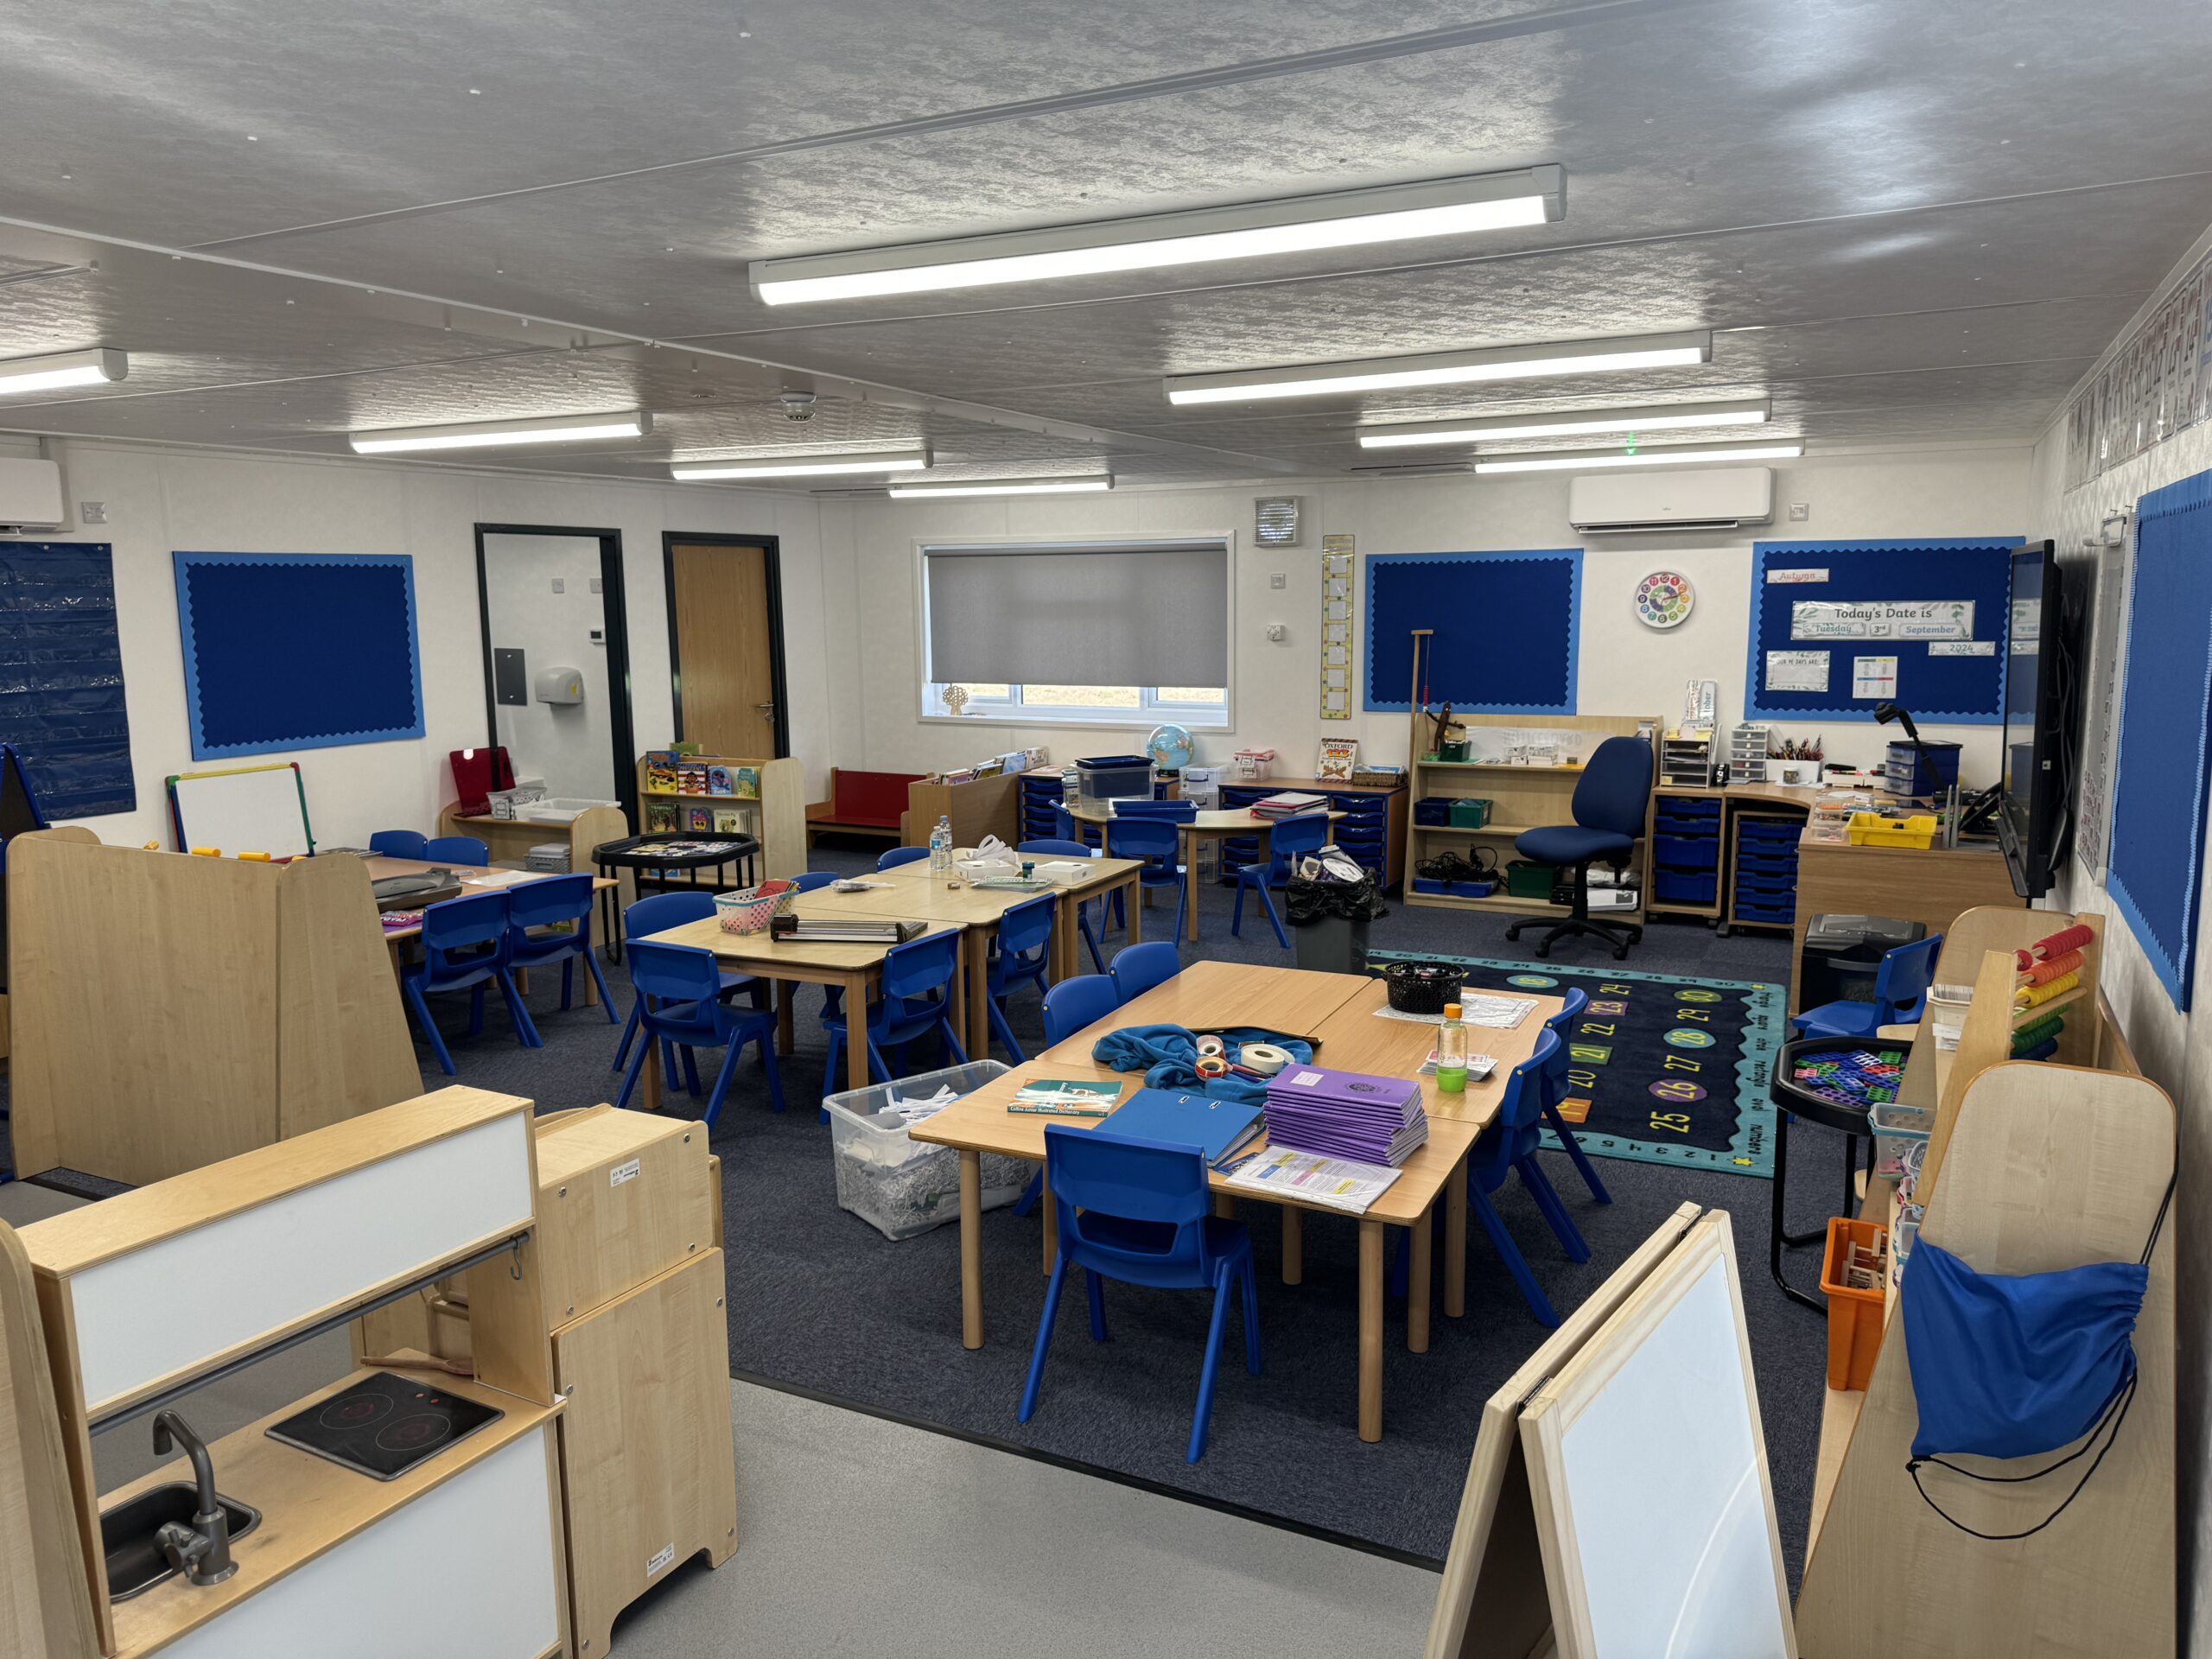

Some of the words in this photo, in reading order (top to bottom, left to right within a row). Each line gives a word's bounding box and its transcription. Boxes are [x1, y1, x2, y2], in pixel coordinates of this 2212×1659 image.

[1778, 571, 1815, 581] Autumn
[1834, 607, 1882, 621] Today's
[1886, 607, 1916, 619] Date
[1921, 607, 1932, 619] is
[1815, 624, 1853, 633] Tuesday
[1906, 626, 1956, 635] September
[1949, 644, 1974, 652] 2024
[1326, 748, 1350, 758] 123
[1599, 983, 1632, 995] 24
[1681, 990, 1715, 1002] 30
[1589, 1001, 1624, 1014] 23
[1675, 1008, 1712, 1022] 29
[1580, 1022, 1616, 1036] 22
[1671, 1031, 1707, 1046] 28
[1570, 1046, 1606, 1059] 21
[1663, 1054, 1702, 1072] 27
[1745, 1059, 1770, 1088] rectangle
[1656, 1081, 1699, 1099] 26
[1751, 1097, 1770, 1111] oval
[1649, 1110, 1691, 1134] 25
[1748, 1124, 1769, 1155] numbers
[1629, 1143, 1642, 1152] 4
[1685, 1150, 1696, 1159] 2
